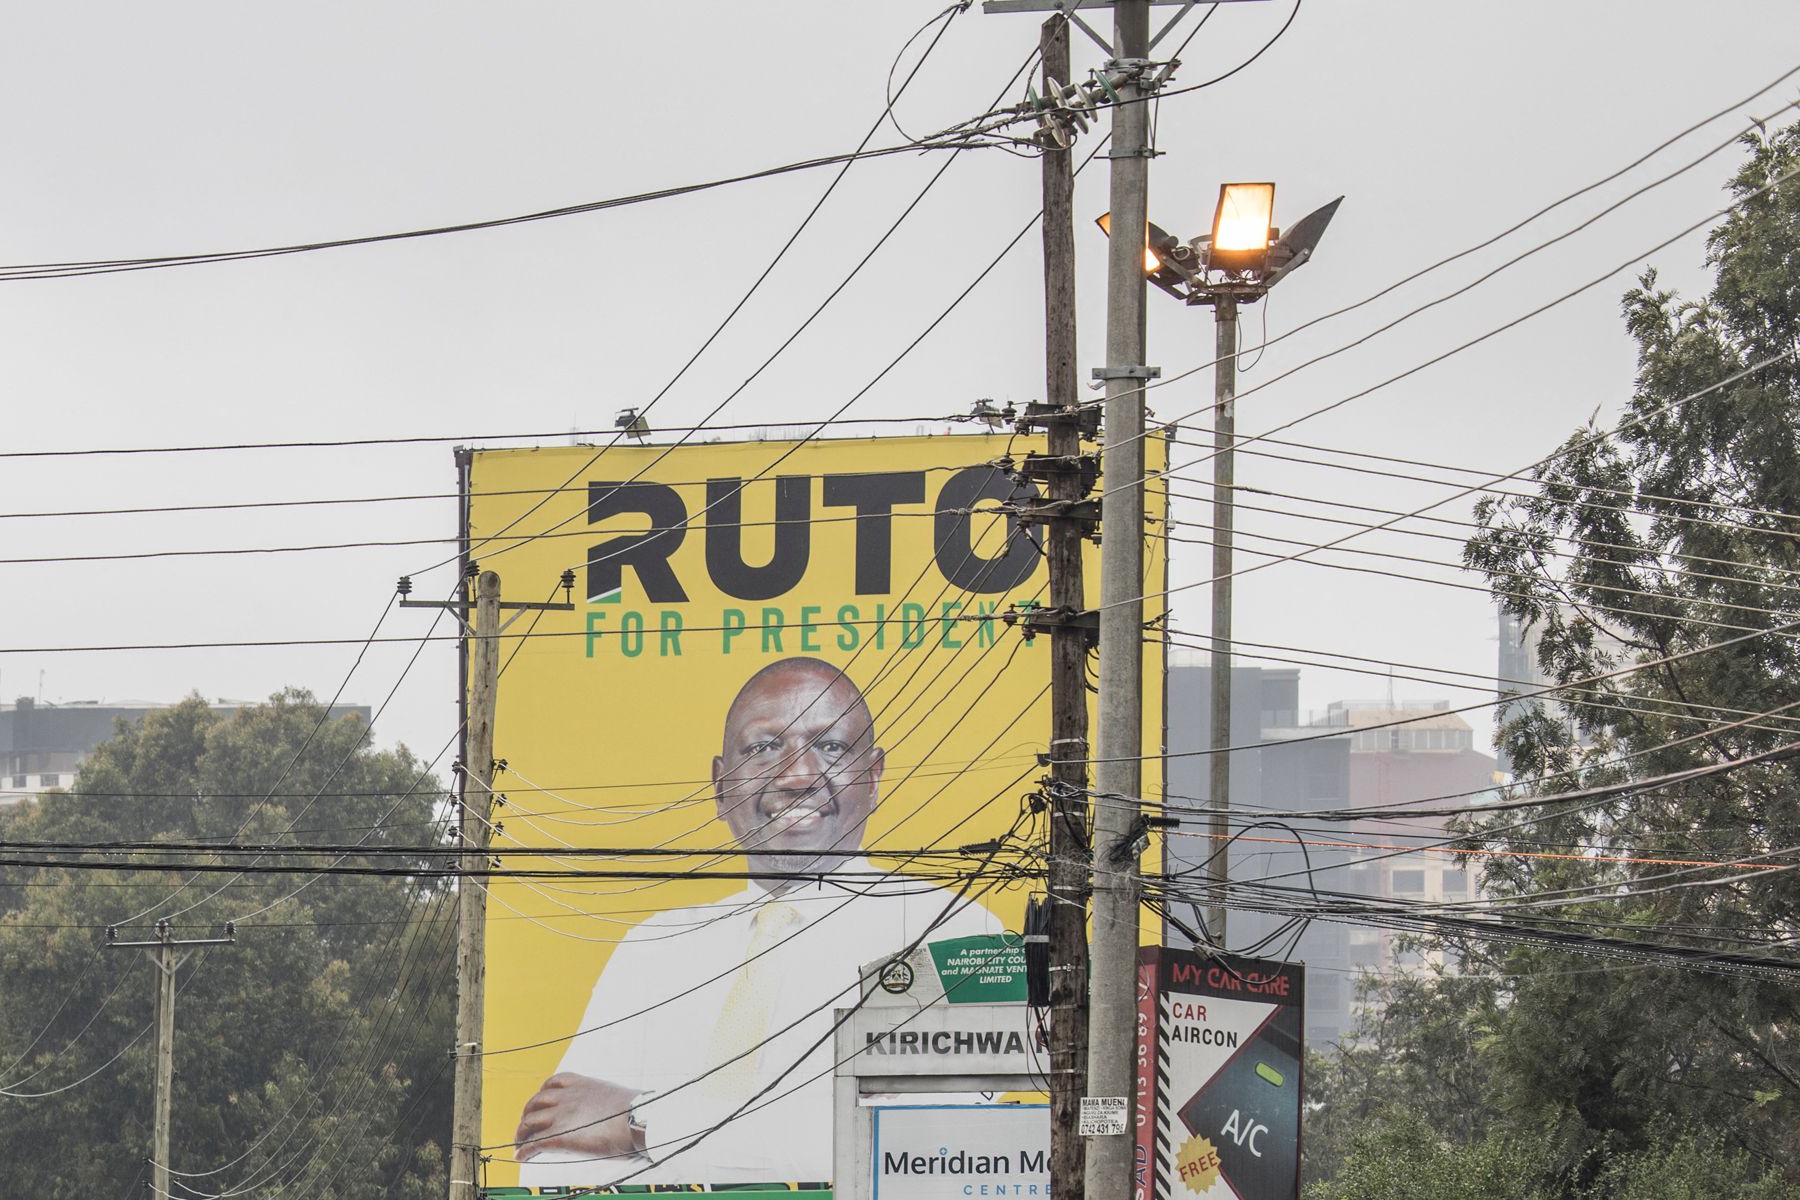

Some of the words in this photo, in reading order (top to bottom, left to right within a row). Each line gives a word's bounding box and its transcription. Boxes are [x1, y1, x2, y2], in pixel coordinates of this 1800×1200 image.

[587, 467, 1042, 603] RUTO
[586, 610, 683, 658] FOR
[723, 599, 1045, 653] PRESIDENT
[947, 957, 986, 966] NAIROBI
[969, 947, 1019, 957] partnership
[941, 967, 959, 976] and
[960, 966, 1004, 975] MAGNATE
[979, 975, 1012, 984] LIMITED
[1172, 962, 1202, 987] MY
[1207, 967, 1242, 991] CAR
[1246, 973, 1290, 996] CARE
[1172, 1002, 1207, 1022] CAR
[866, 1031, 1026, 1055] KIRICHWA
[1171, 1024, 1238, 1049] AIRCON
[1101, 1098, 1125, 1106] MUENI
[1220, 1108, 1269, 1158] A/C
[885, 1147, 1009, 1175] Meridian
[1179, 1151, 1221, 1182] FREE
[963, 1184, 1051, 1196] CENTRE
